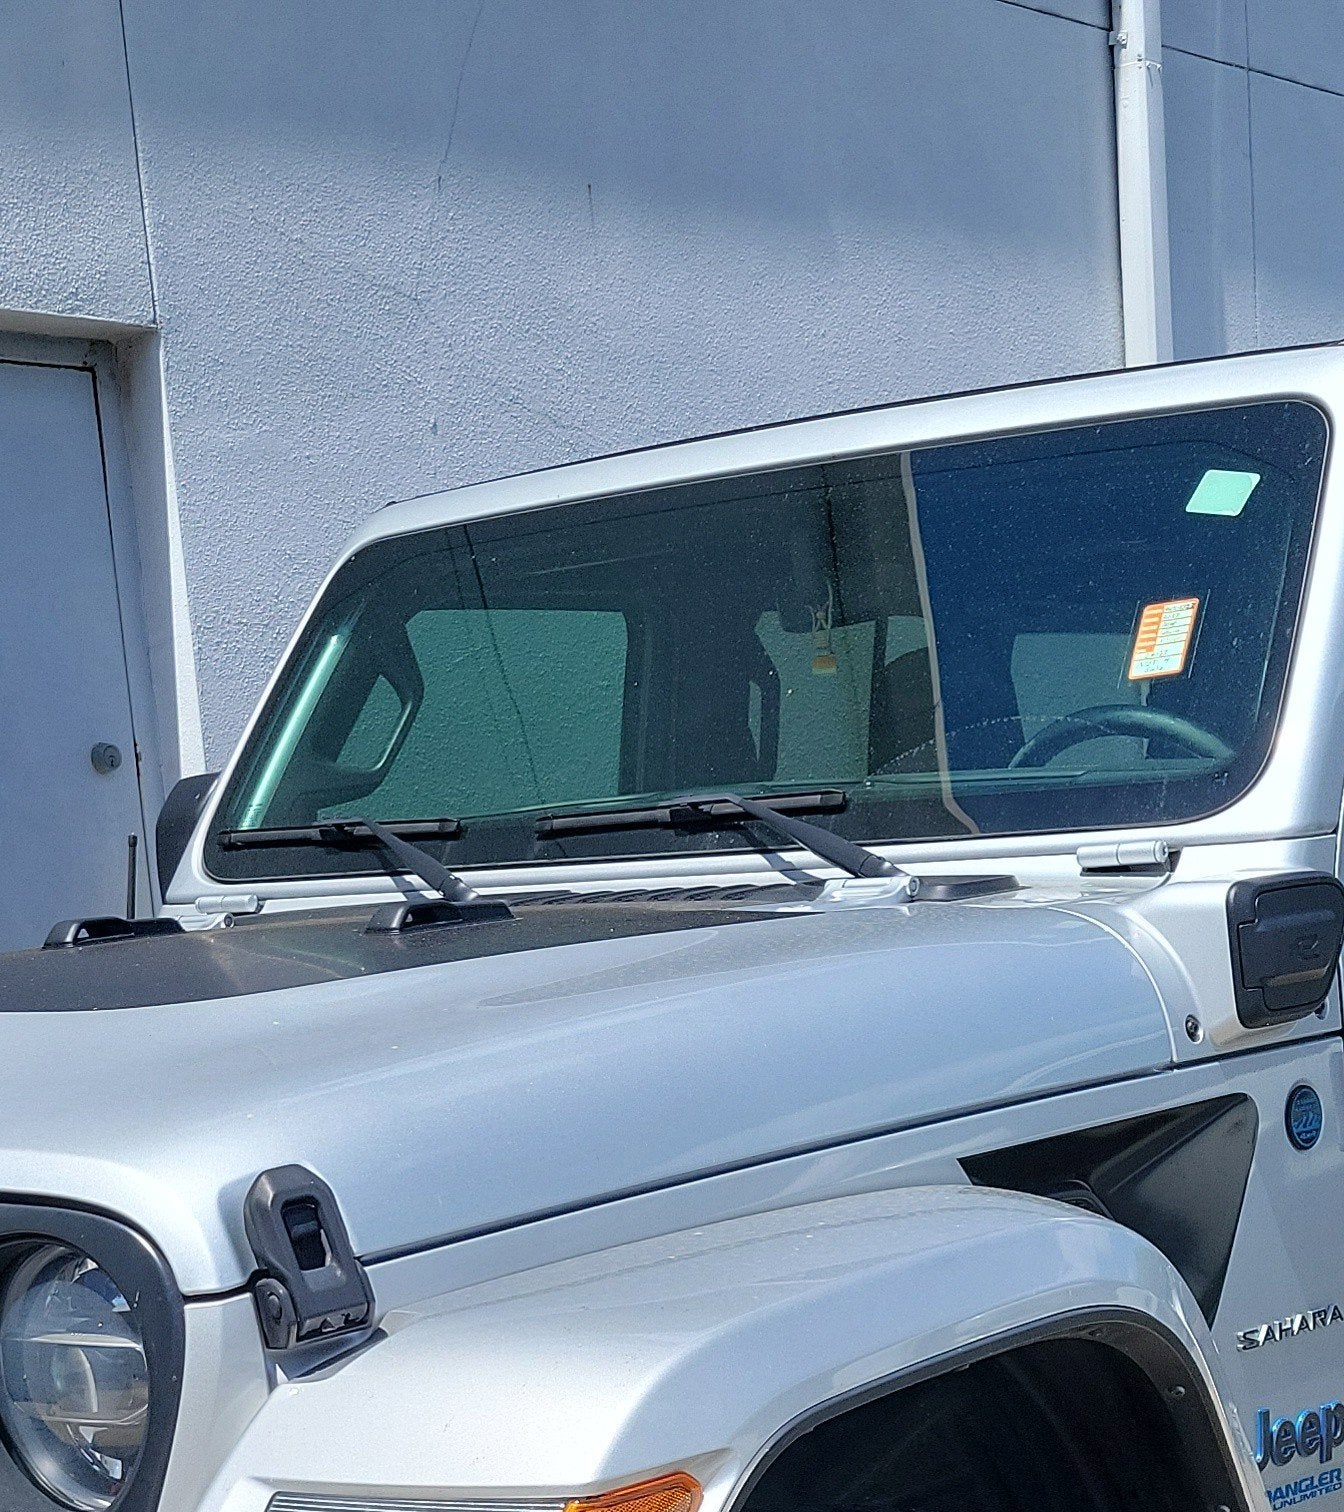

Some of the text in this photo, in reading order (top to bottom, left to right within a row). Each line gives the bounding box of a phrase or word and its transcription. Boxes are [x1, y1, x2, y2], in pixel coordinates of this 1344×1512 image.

[1236, 1304, 1344, 1352] SAHARA
[1266, 1468, 1342, 1503] ANGLER
[1273, 1483, 1342, 1511] UNLIMITED
